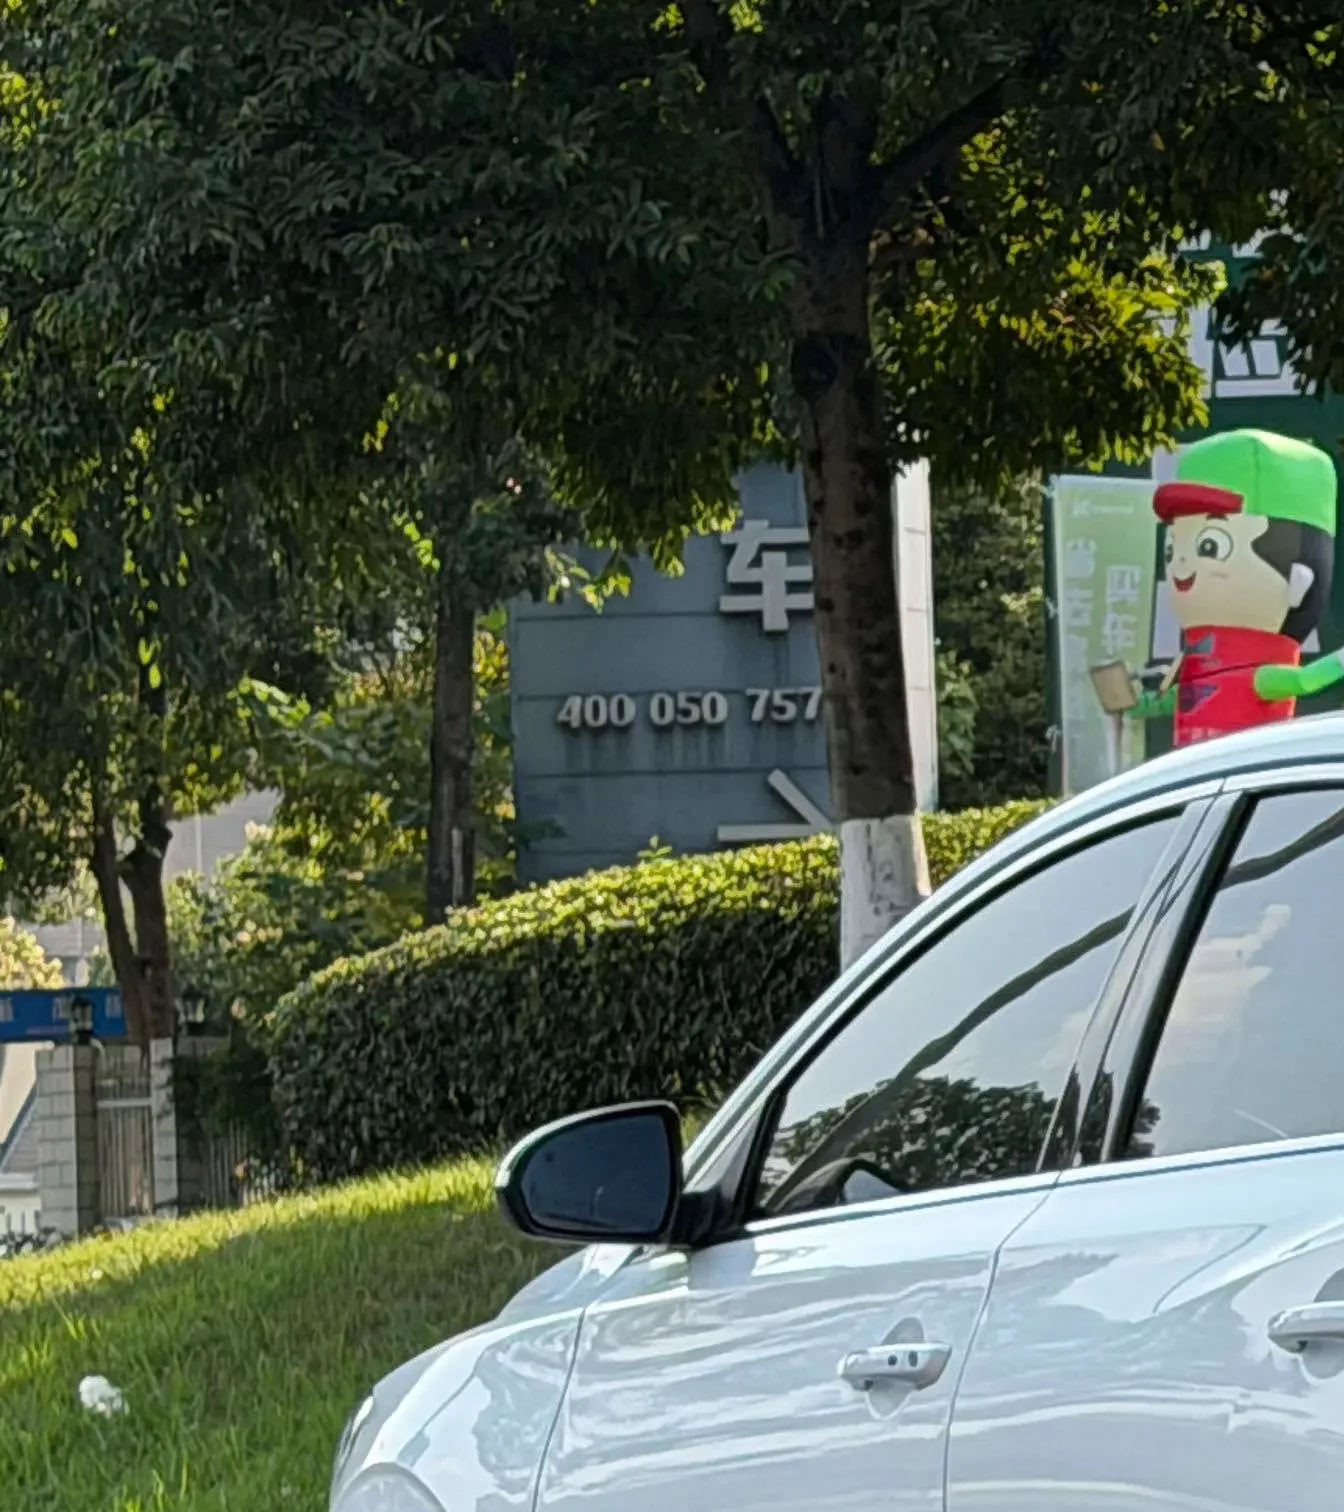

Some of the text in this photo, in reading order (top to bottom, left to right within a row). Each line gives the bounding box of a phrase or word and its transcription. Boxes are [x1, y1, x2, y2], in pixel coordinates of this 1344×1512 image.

[719, 519, 815, 632] 车
[556, 693, 637, 731] 400
[649, 690, 729, 728] 050
